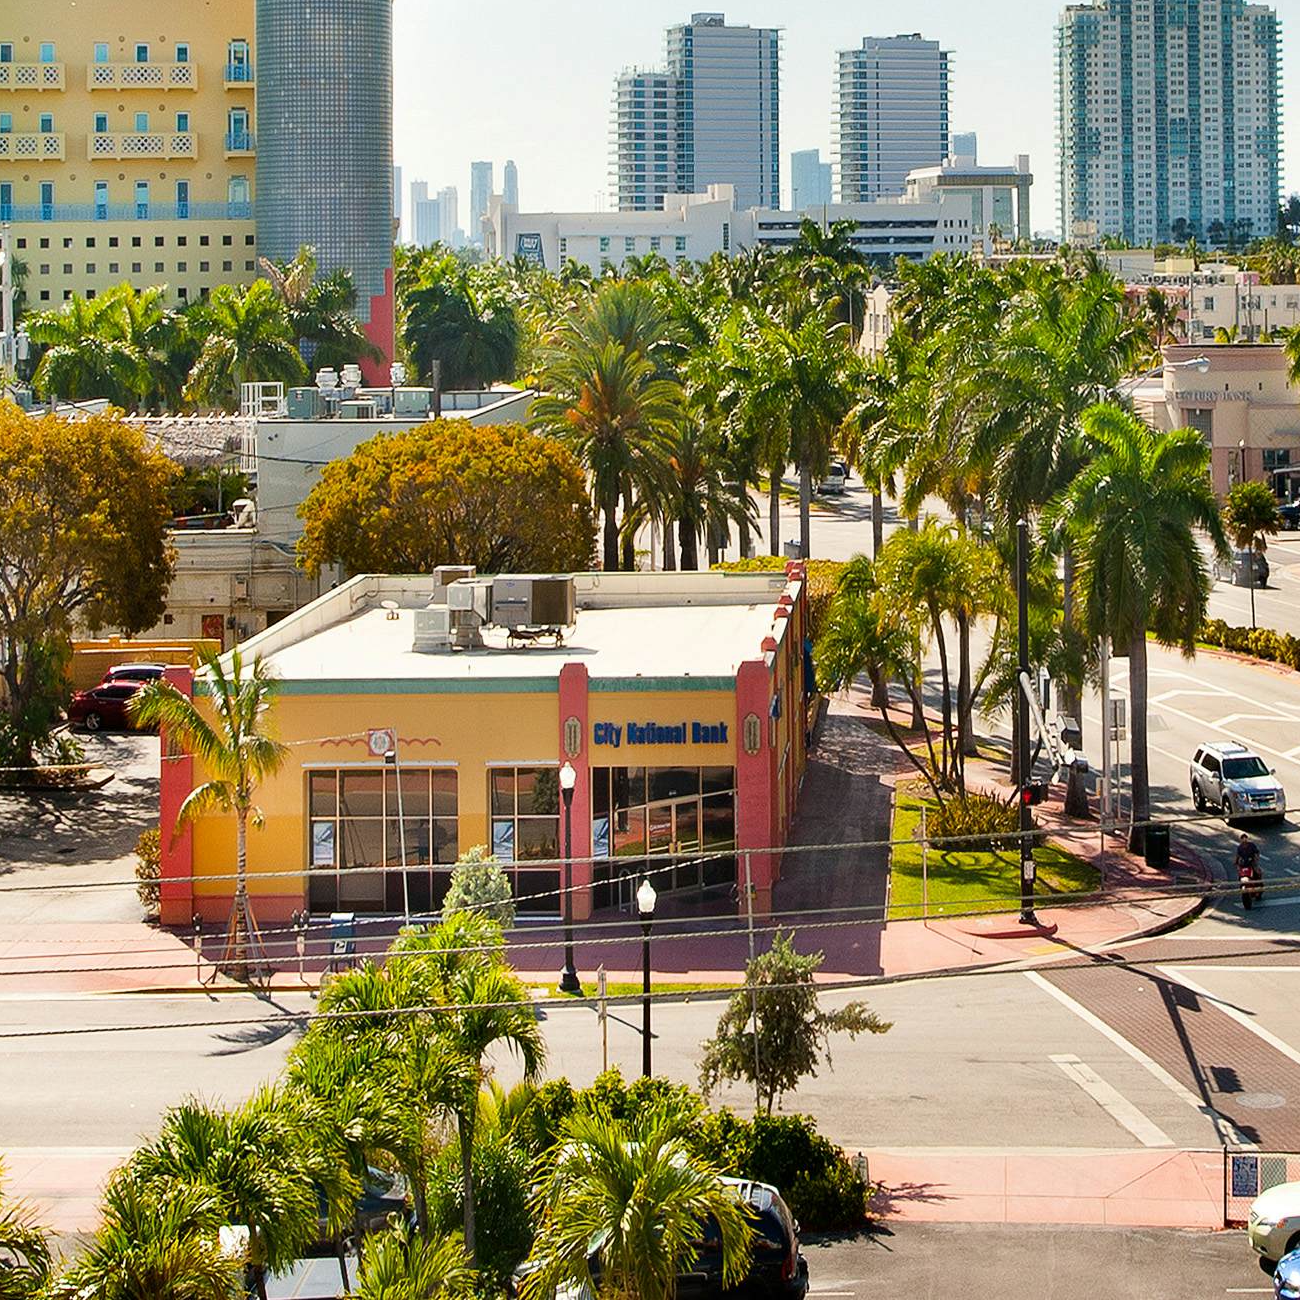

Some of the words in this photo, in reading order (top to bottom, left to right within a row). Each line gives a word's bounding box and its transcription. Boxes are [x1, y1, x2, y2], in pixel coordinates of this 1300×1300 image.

[593, 722, 622, 748] City
[626, 721, 687, 745] National
[691, 720, 729, 744] Bank
